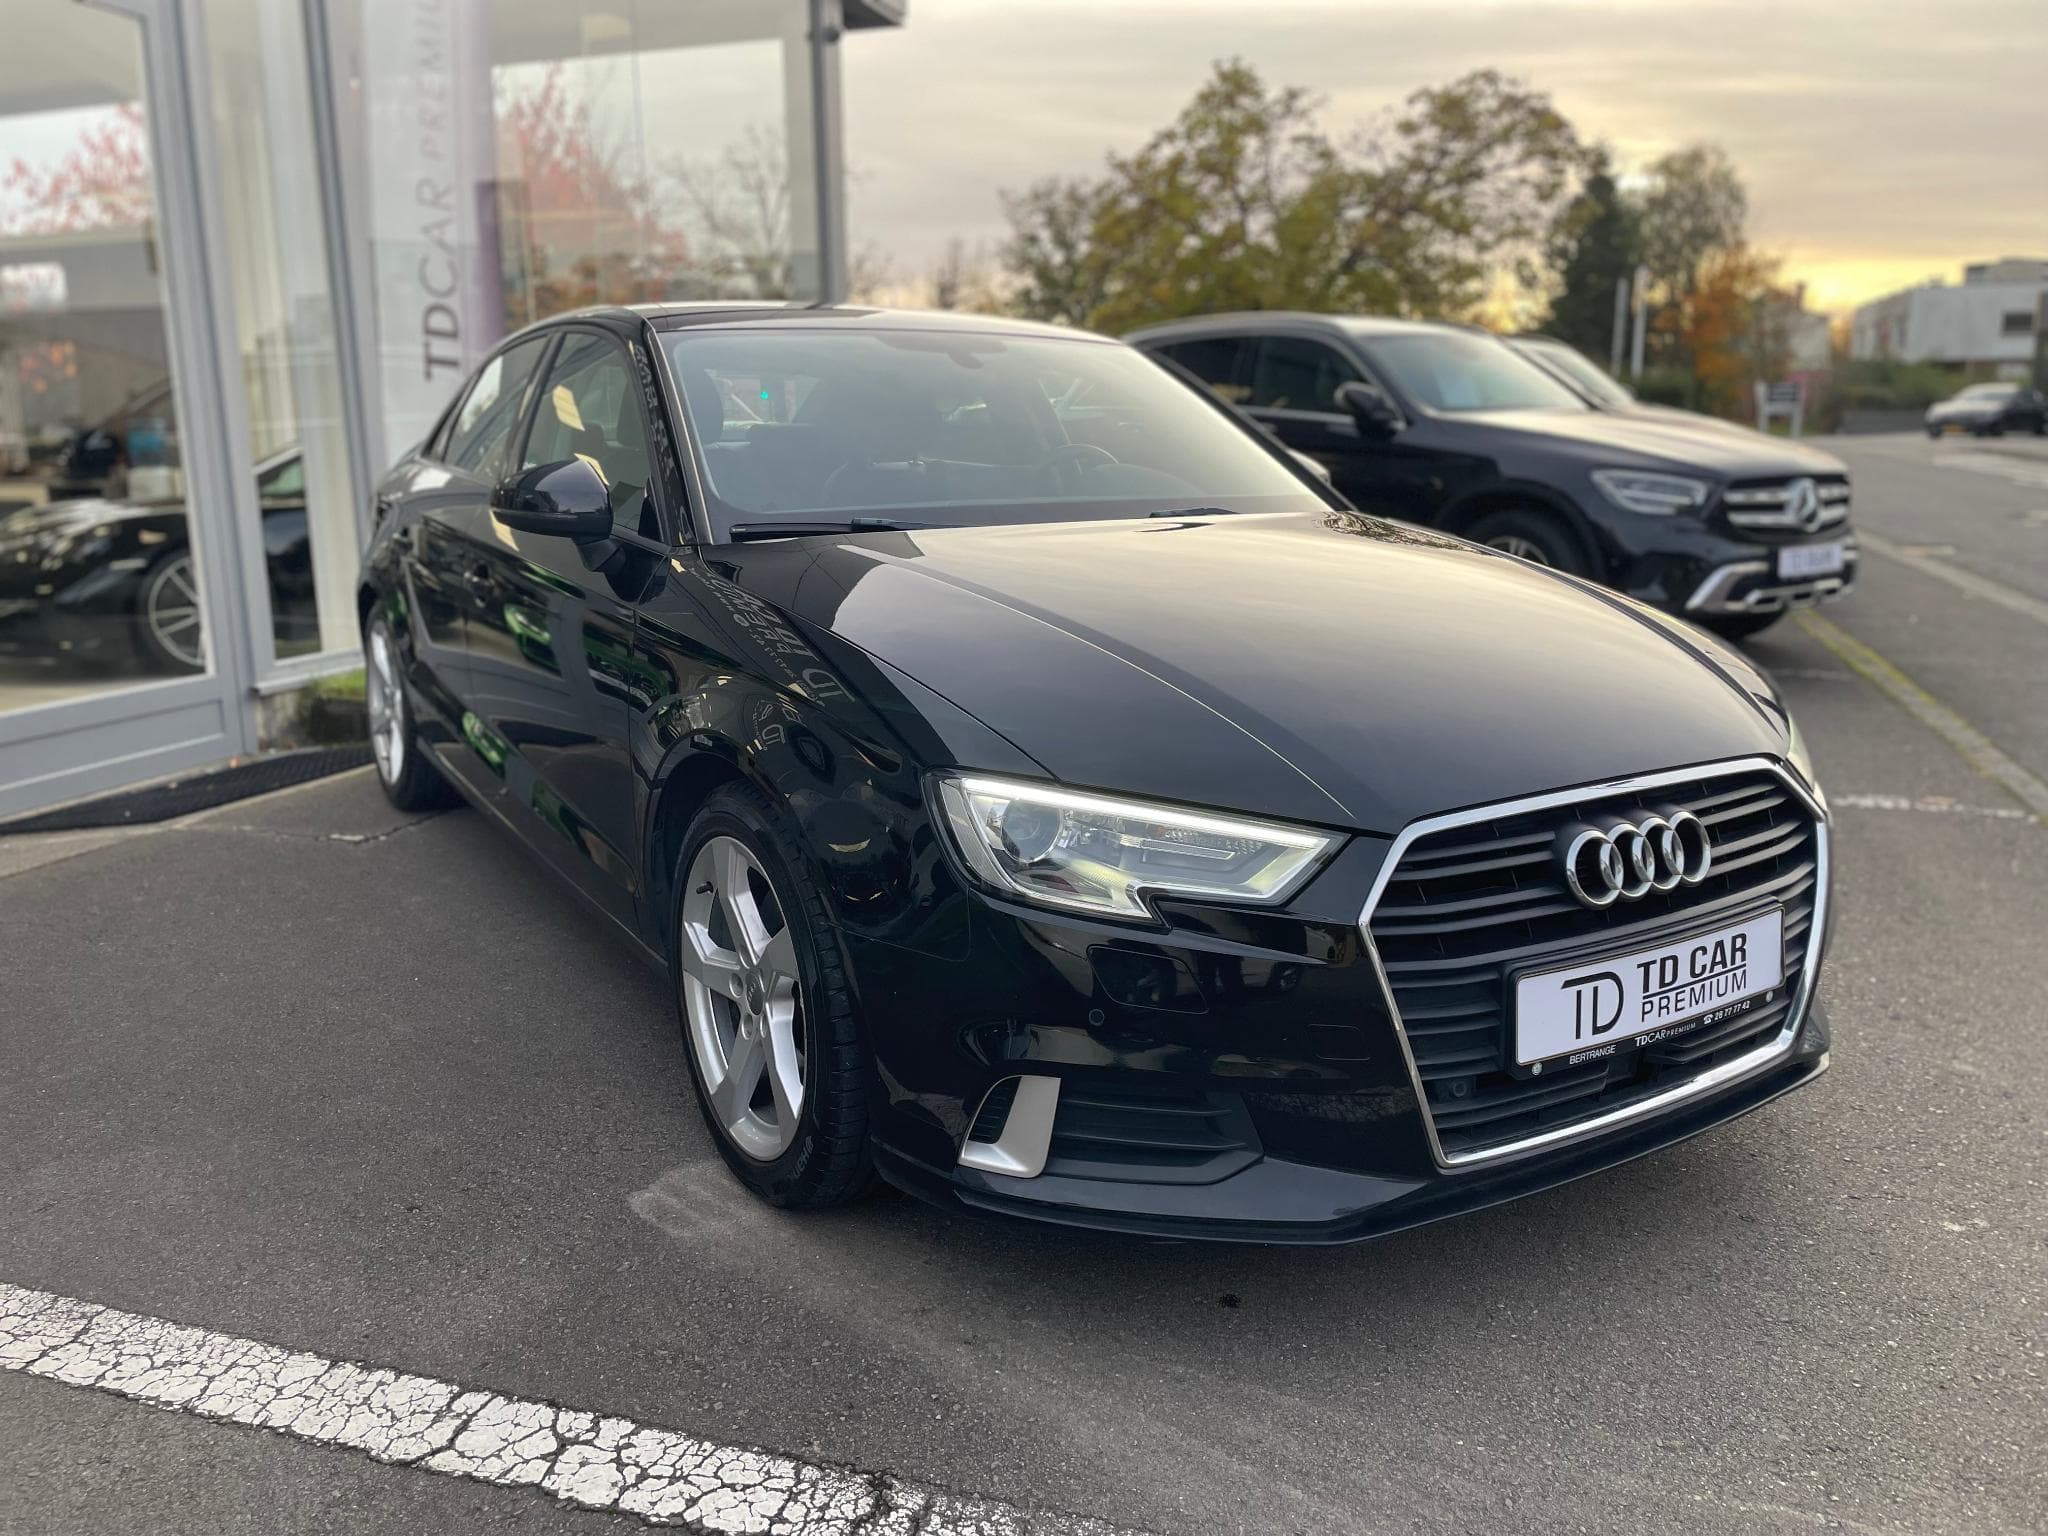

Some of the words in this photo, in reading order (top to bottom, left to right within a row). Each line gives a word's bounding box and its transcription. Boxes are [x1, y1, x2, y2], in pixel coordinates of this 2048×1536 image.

[1636, 954, 1679, 994] TD
[1689, 933, 1747, 979] CAR
[1561, 971, 1624, 1040] TD
[1641, 969, 1747, 1023] PREMIUM
[1569, 1044, 1617, 1065] BERTRANGE
